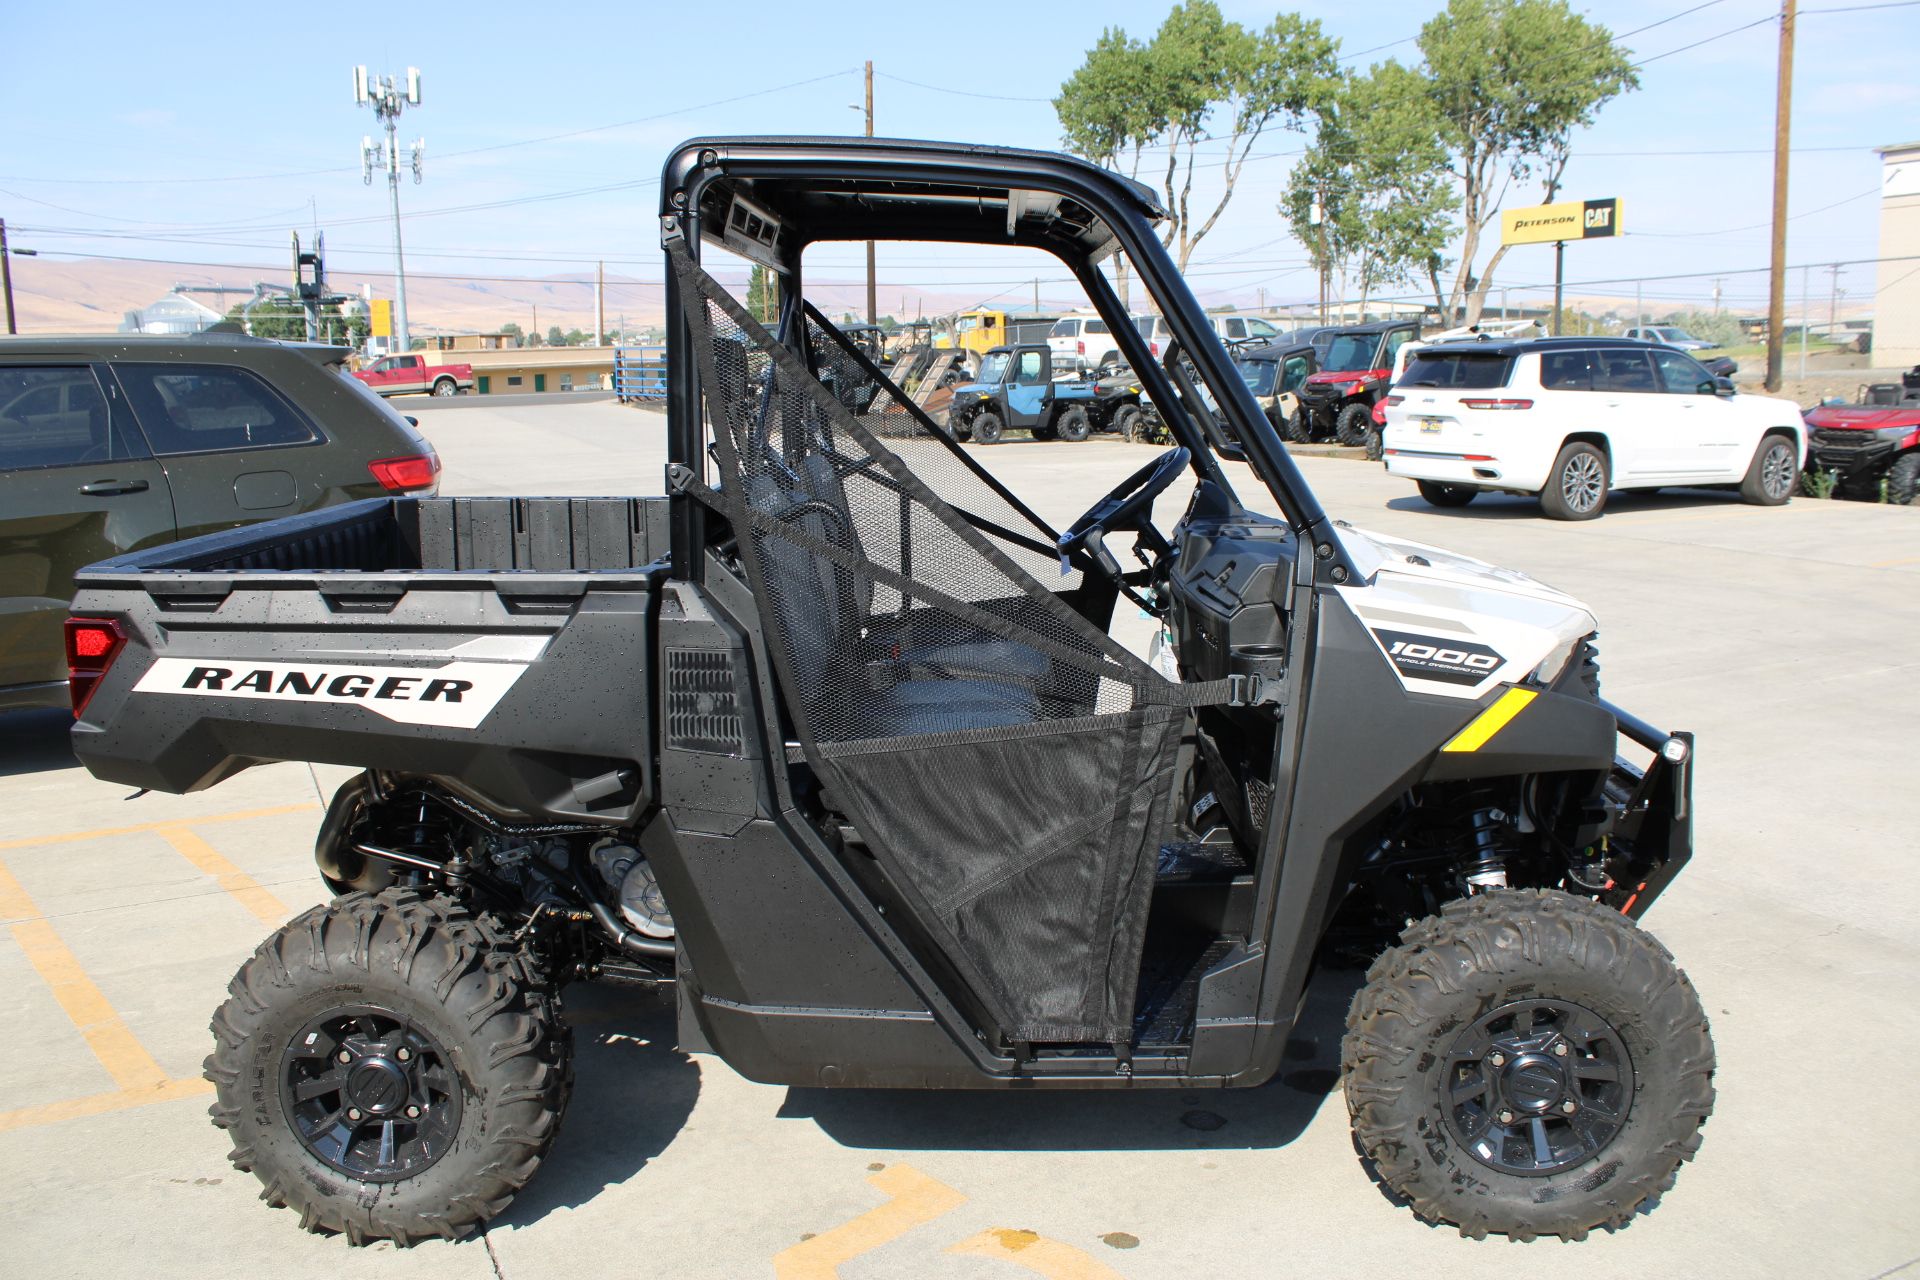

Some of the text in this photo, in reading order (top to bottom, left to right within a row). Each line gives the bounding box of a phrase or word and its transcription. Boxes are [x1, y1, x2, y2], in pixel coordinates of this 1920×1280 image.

[1514, 207, 1613, 231] PETERSON CAT
[1390, 641, 1499, 669] 1000
[1396, 657, 1426, 666] SINGLE
[182, 666, 473, 703] RANGER
